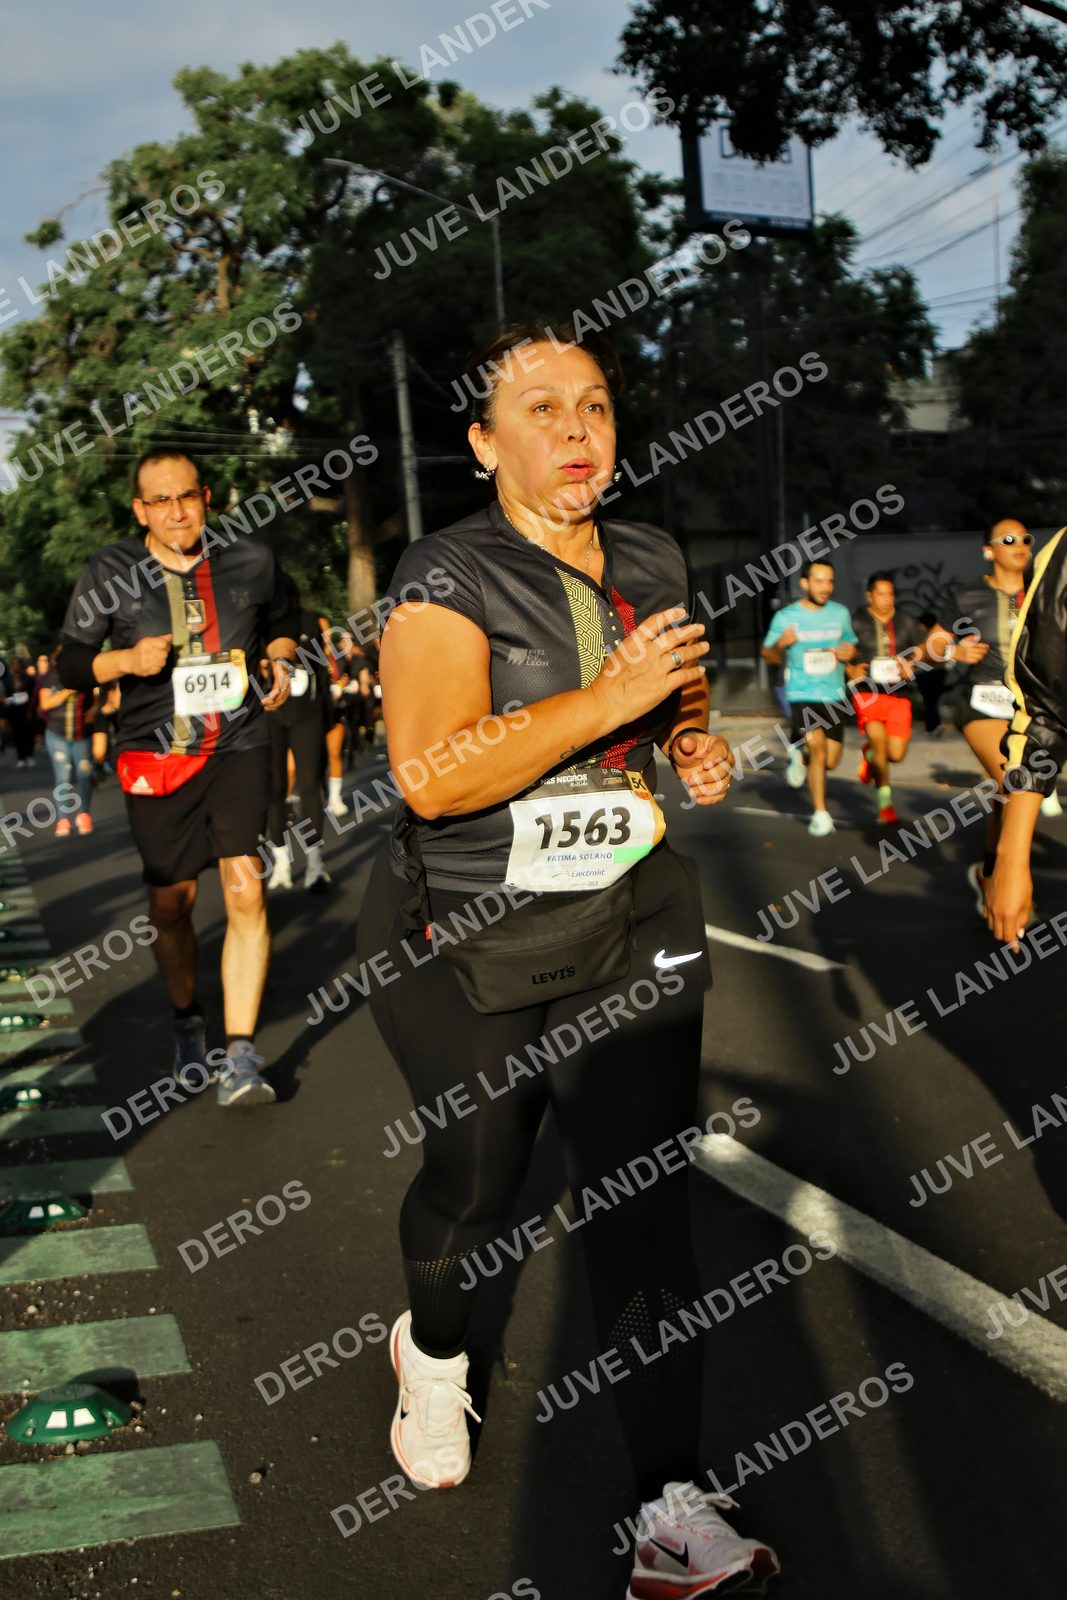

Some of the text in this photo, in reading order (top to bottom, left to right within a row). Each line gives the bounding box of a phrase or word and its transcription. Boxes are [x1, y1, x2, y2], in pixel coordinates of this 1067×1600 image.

[184, 670, 231, 693] 6914
[556, 773, 588, 784] NEGROS
[535, 806, 631, 850] 1563
[579, 852, 613, 861] SOLANO
[571, 869, 605, 878] Electrolit
